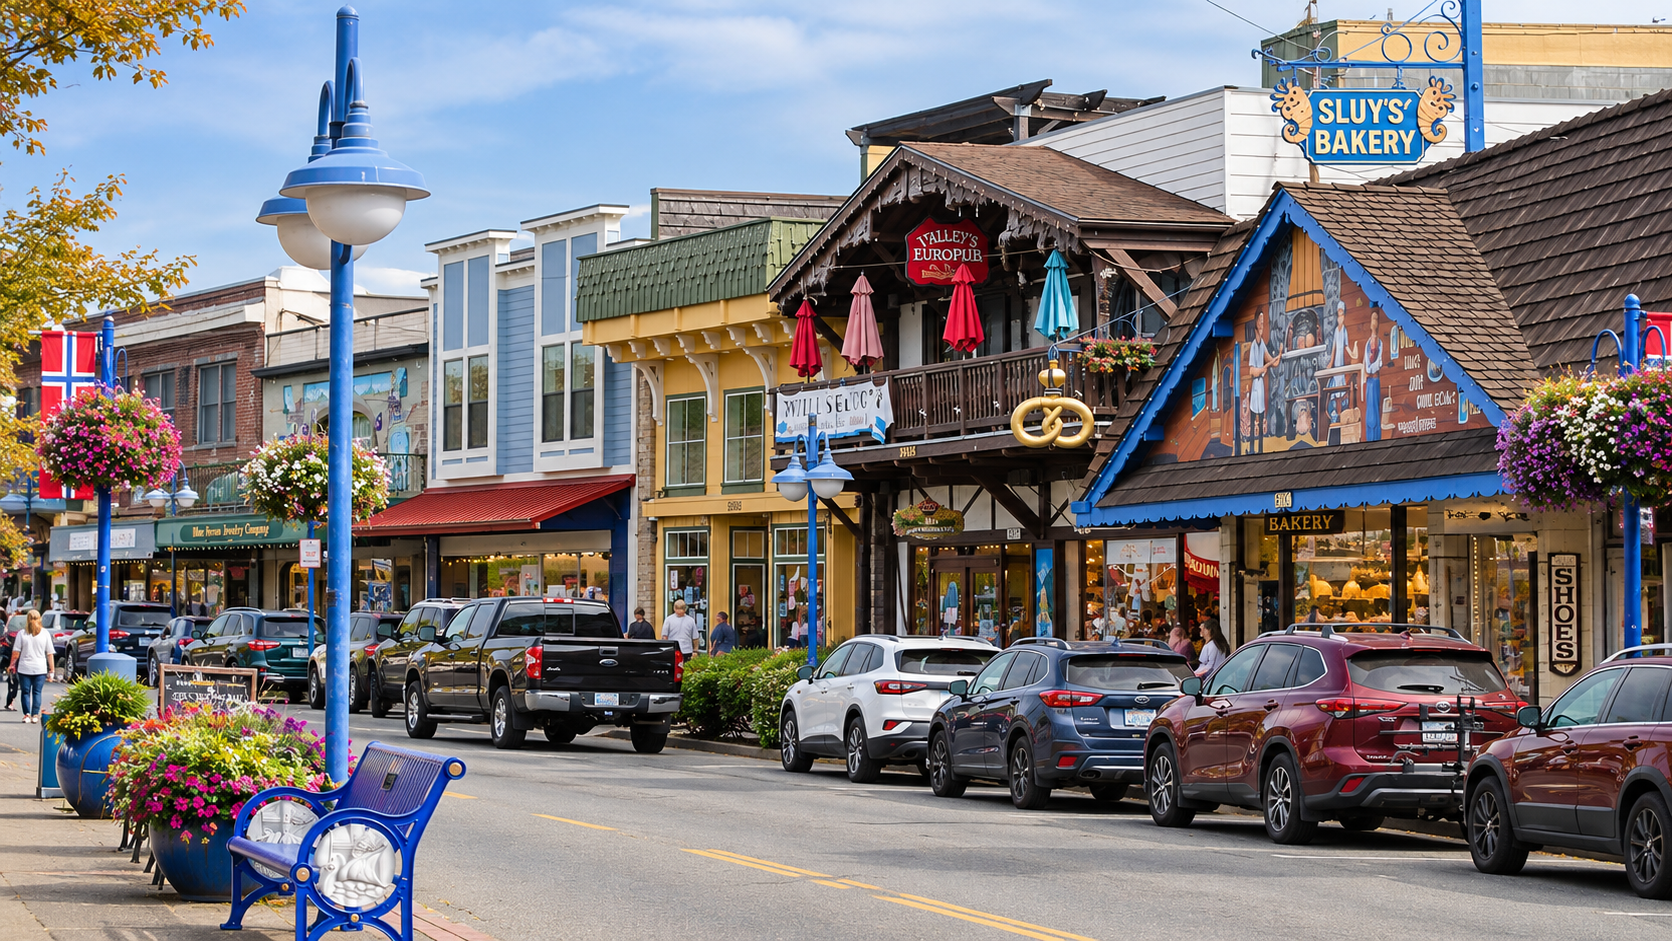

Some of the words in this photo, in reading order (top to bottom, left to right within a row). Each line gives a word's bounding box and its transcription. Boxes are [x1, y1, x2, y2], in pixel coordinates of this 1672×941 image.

[1315, 129, 1416, 155] BAKERY
[912, 247, 983, 262] EUROPUB
[1269, 515, 1334, 531] BAKERY
[1554, 568, 1575, 659] SHOES
